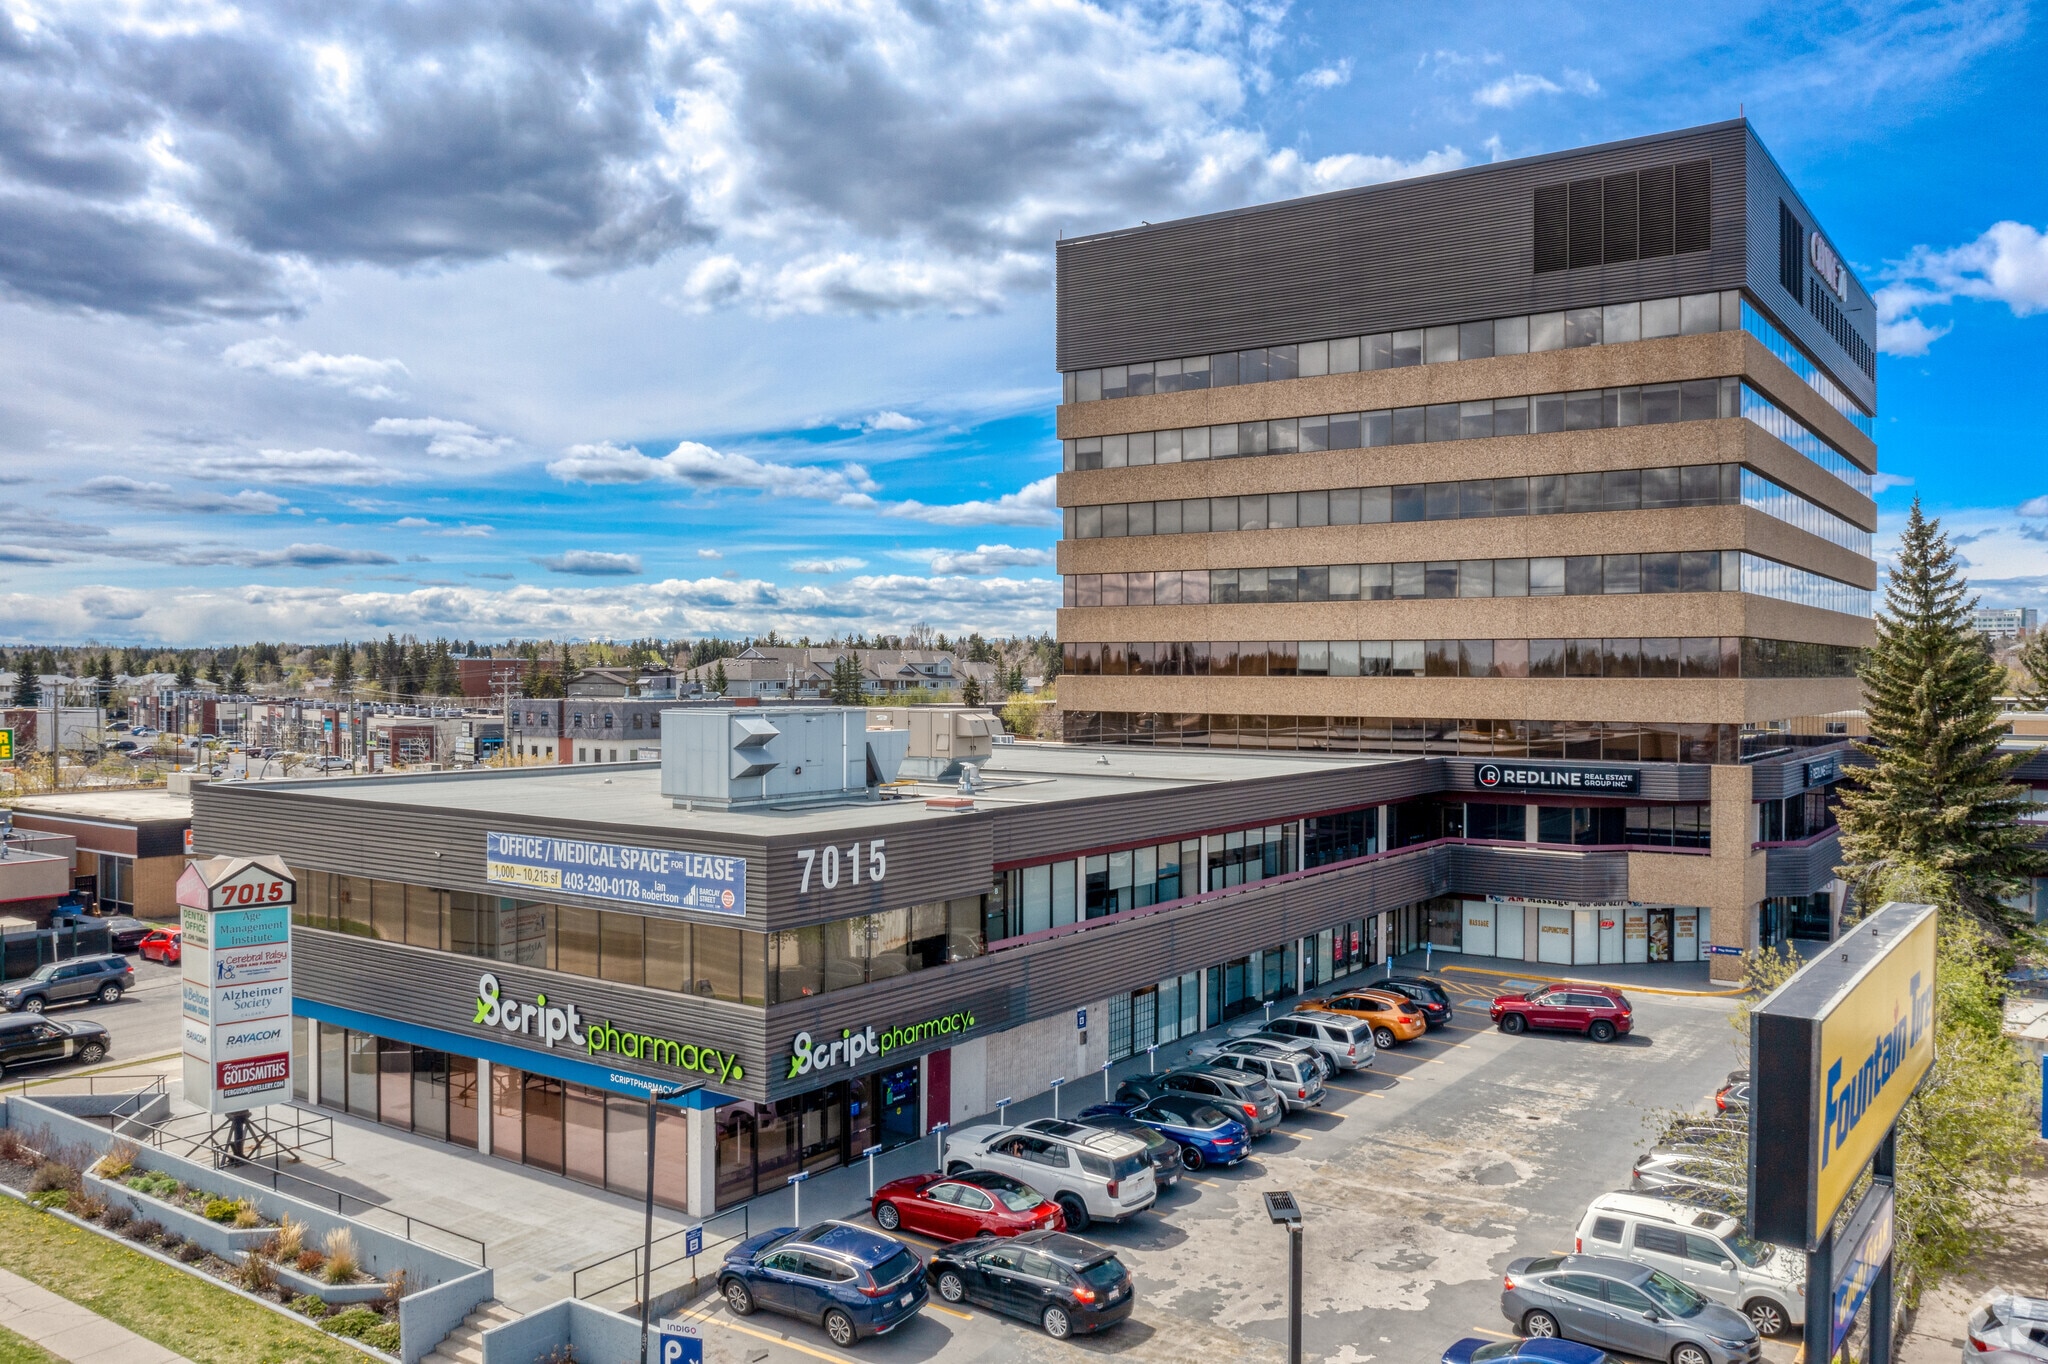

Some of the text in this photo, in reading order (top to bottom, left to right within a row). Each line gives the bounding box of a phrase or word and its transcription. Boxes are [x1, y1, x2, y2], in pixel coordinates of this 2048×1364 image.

[1503, 770, 1582, 786] REDLINE
[1584, 773, 1633, 782] REAL ESTATE
[500, 835, 543, 860] OFFICE
[554, 841, 617, 868] MEDICAL
[620, 848, 669, 874] SPACE
[671, 860, 683, 869] FOR
[685, 855, 734, 881] LEASE
[797, 839, 886, 894] 7015
[495, 864, 515, 878] 1,000
[524, 868, 549, 883] 10,215
[550, 872, 558, 884] sf
[564, 871, 640, 898] 403-290-0178
[654, 880, 666, 892] Ian
[221, 881, 284, 906] 7015
[641, 889, 679, 904] Robertson
[699, 887, 720, 897] BARCLAY
[699, 895, 716, 904] STREET
[183, 909, 208, 924] DENTAL
[242, 911, 262, 922] Age
[184, 920, 207, 934] OFFICE
[220, 921, 283, 935] Management
[231, 933, 273, 945] Institute
[226, 949, 287, 965] Cerebral Palsy
[222, 987, 284, 1001] Alzheimer
[233, 997, 272, 1010] Society
[472, 973, 586, 1048] Script
[226, 1029, 281, 1046] RAYACOM
[788, 1026, 879, 1079] Script
[223, 1062, 286, 1086] GOLDSMITHS
[1821, 1012, 1907, 1172] Fountain
[1909, 970, 1933, 1050] Tire
[667, 1323, 697, 1335] INDIGO
